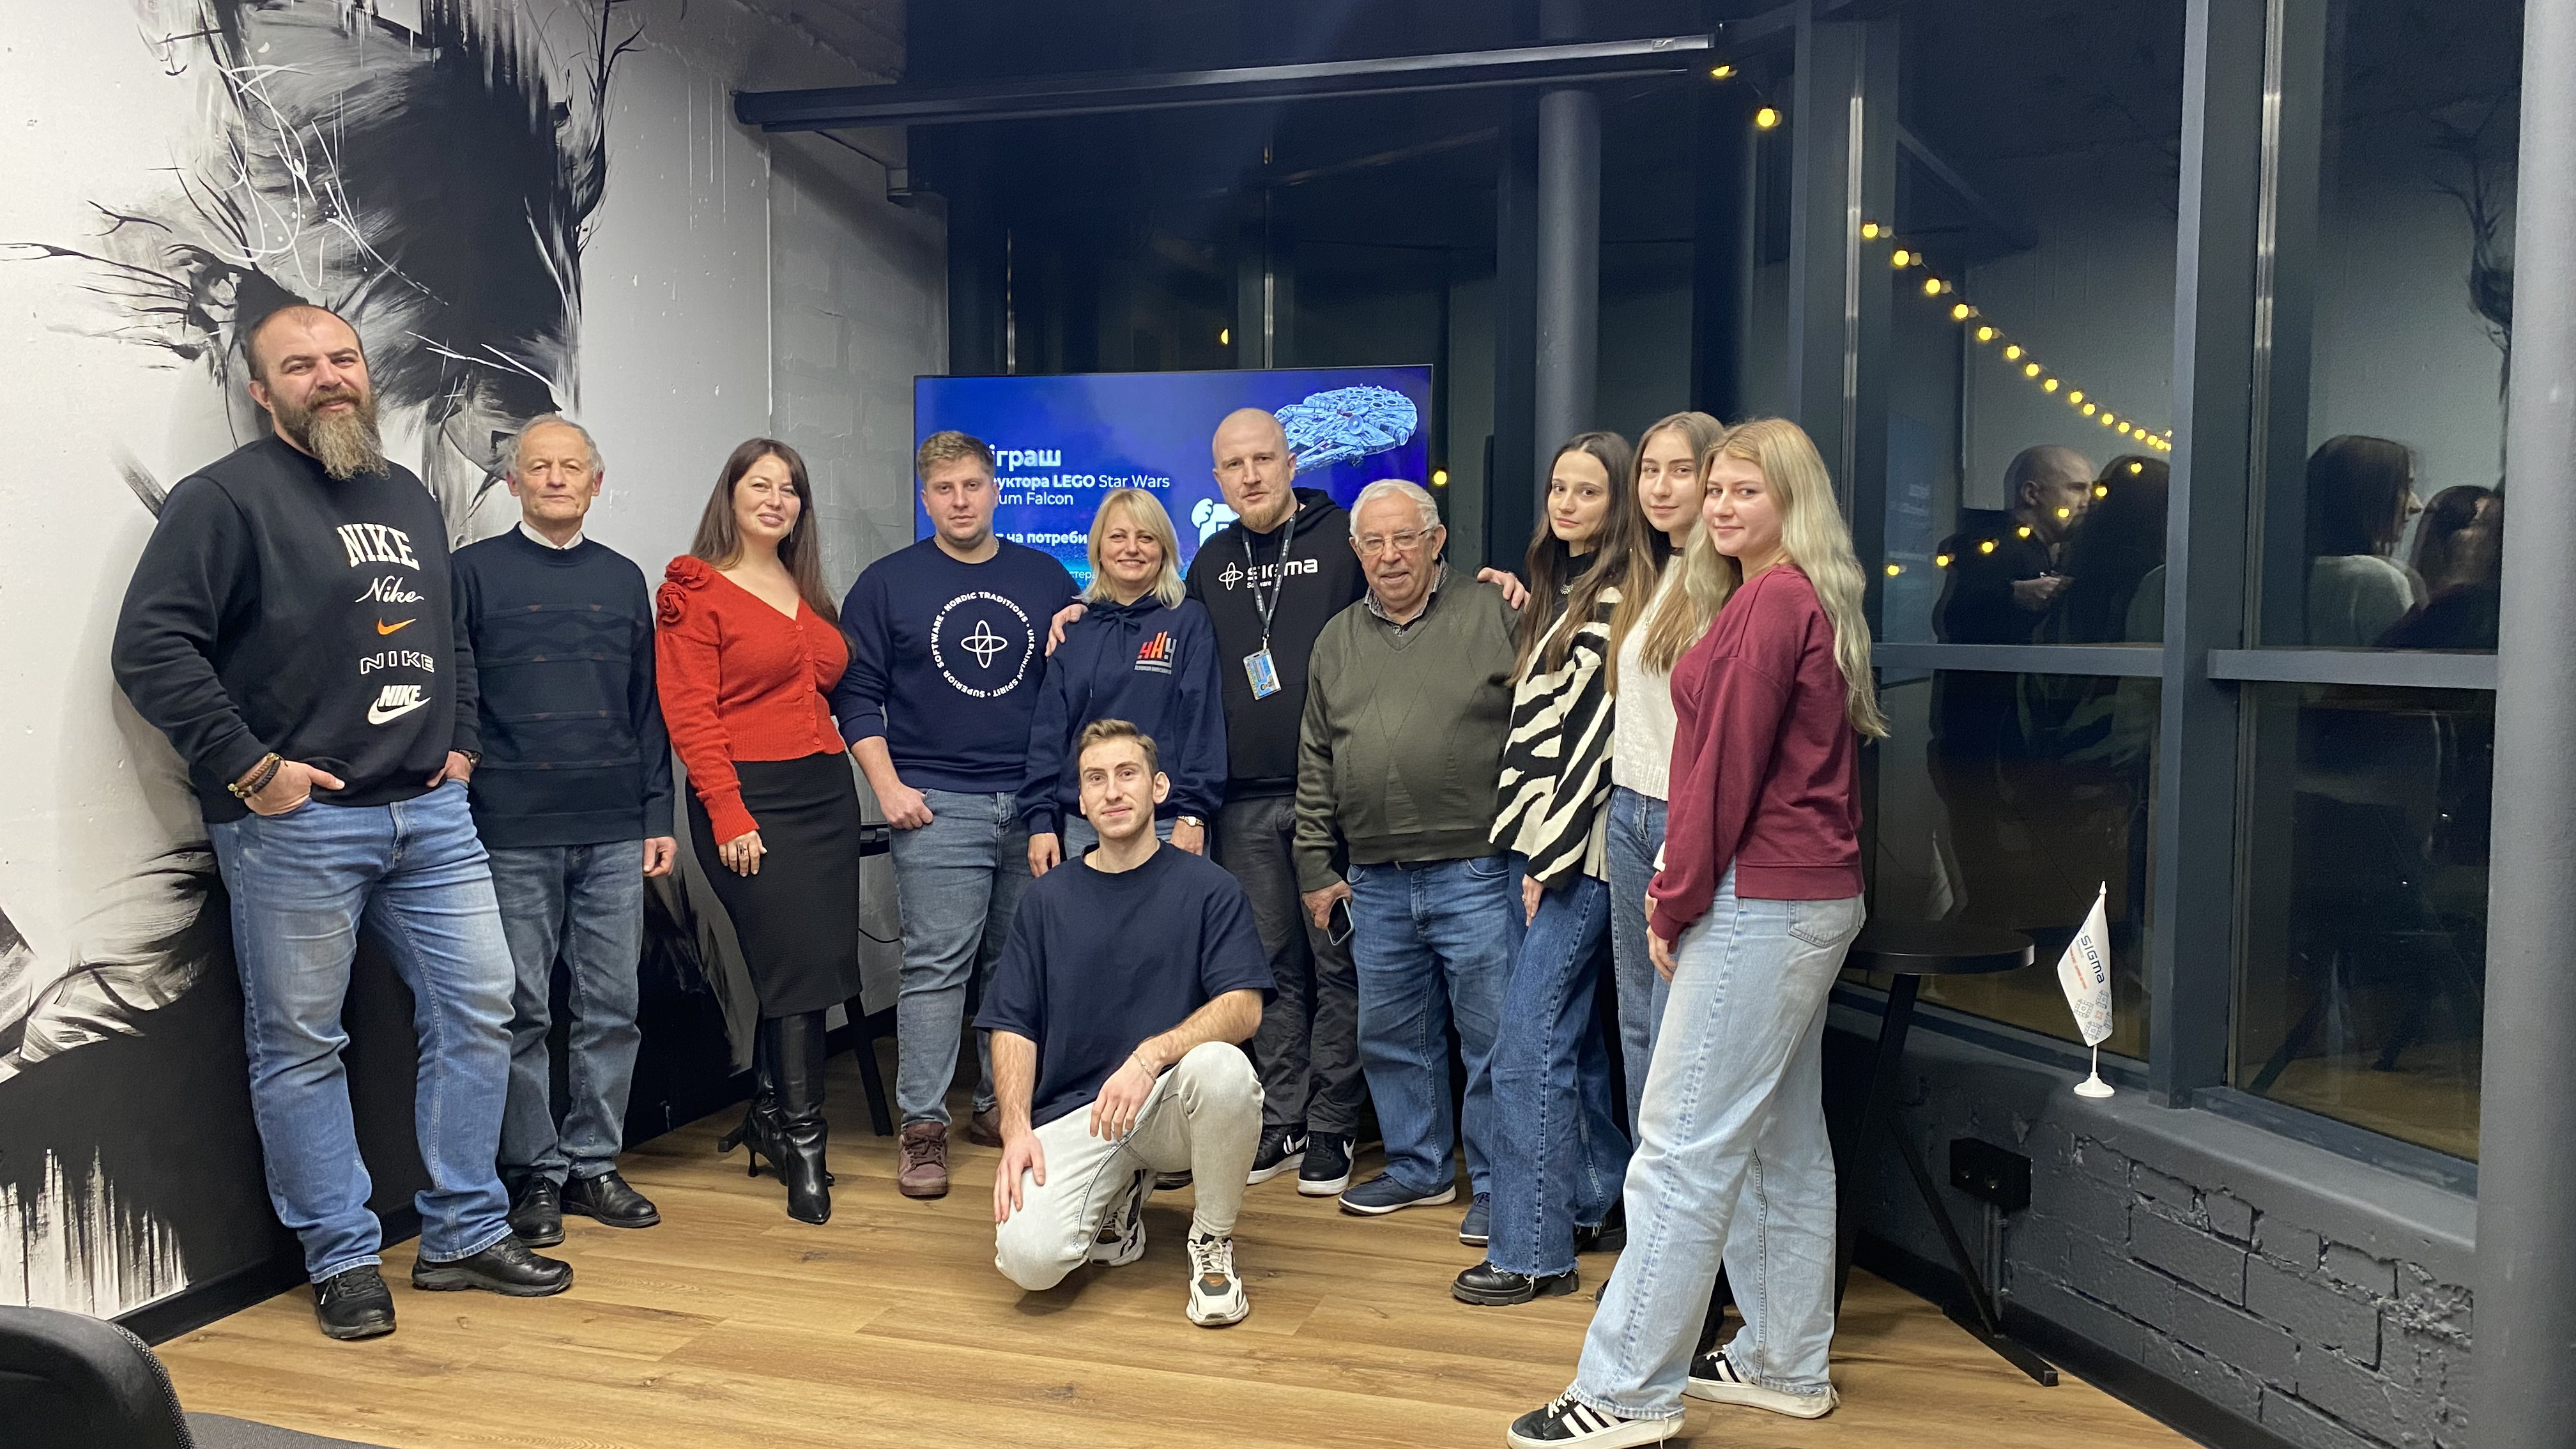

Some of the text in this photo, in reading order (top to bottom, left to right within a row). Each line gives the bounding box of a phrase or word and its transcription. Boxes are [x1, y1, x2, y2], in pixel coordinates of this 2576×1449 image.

[993, 475, 1170, 491] уктора LEGO Star Wars
[1027, 491, 1074, 505] Falcon
[336, 523, 420, 571] NIKE
[1026, 530, 1087, 546] потреби
[355, 575, 425, 603] Nike
[931, 591, 1035, 698] SUPERIOR SOFTWARE NORDIC TRADITIONS UKRAINIAN SPIRIT
[360, 650, 434, 675] NIKE
[378, 684, 422, 707] NIKE
